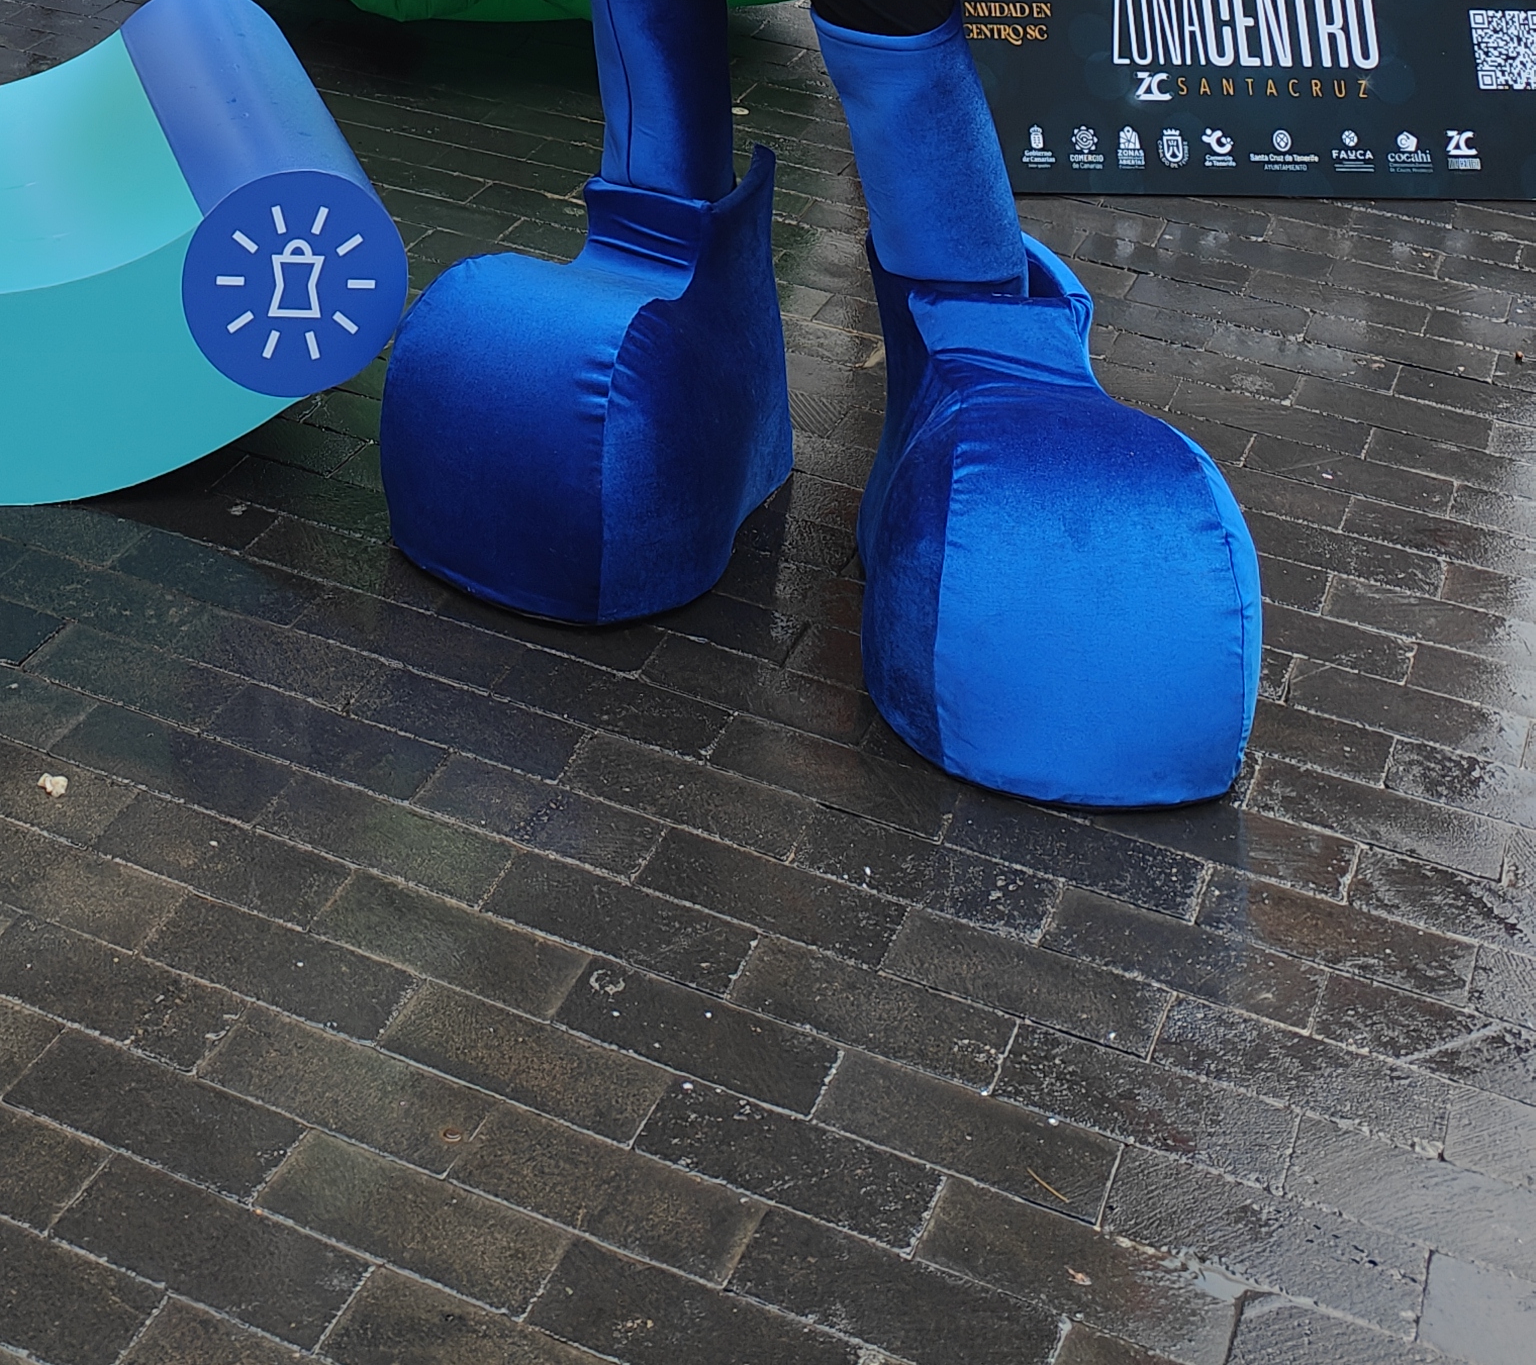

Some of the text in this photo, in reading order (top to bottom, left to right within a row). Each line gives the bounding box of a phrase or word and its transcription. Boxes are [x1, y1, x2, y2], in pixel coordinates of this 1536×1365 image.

[964, 1, 1052, 18] NAVIDAD EN
[963, 23, 1048, 45] CENTRO SC
[1069, 154, 1104, 162] COMERCIO
[1250, 154, 1268, 162] Santa
[1269, 154, 1284, 162] Cruz
[1285, 154, 1292, 162] de
[1388, 150, 1431, 162] cocahi
